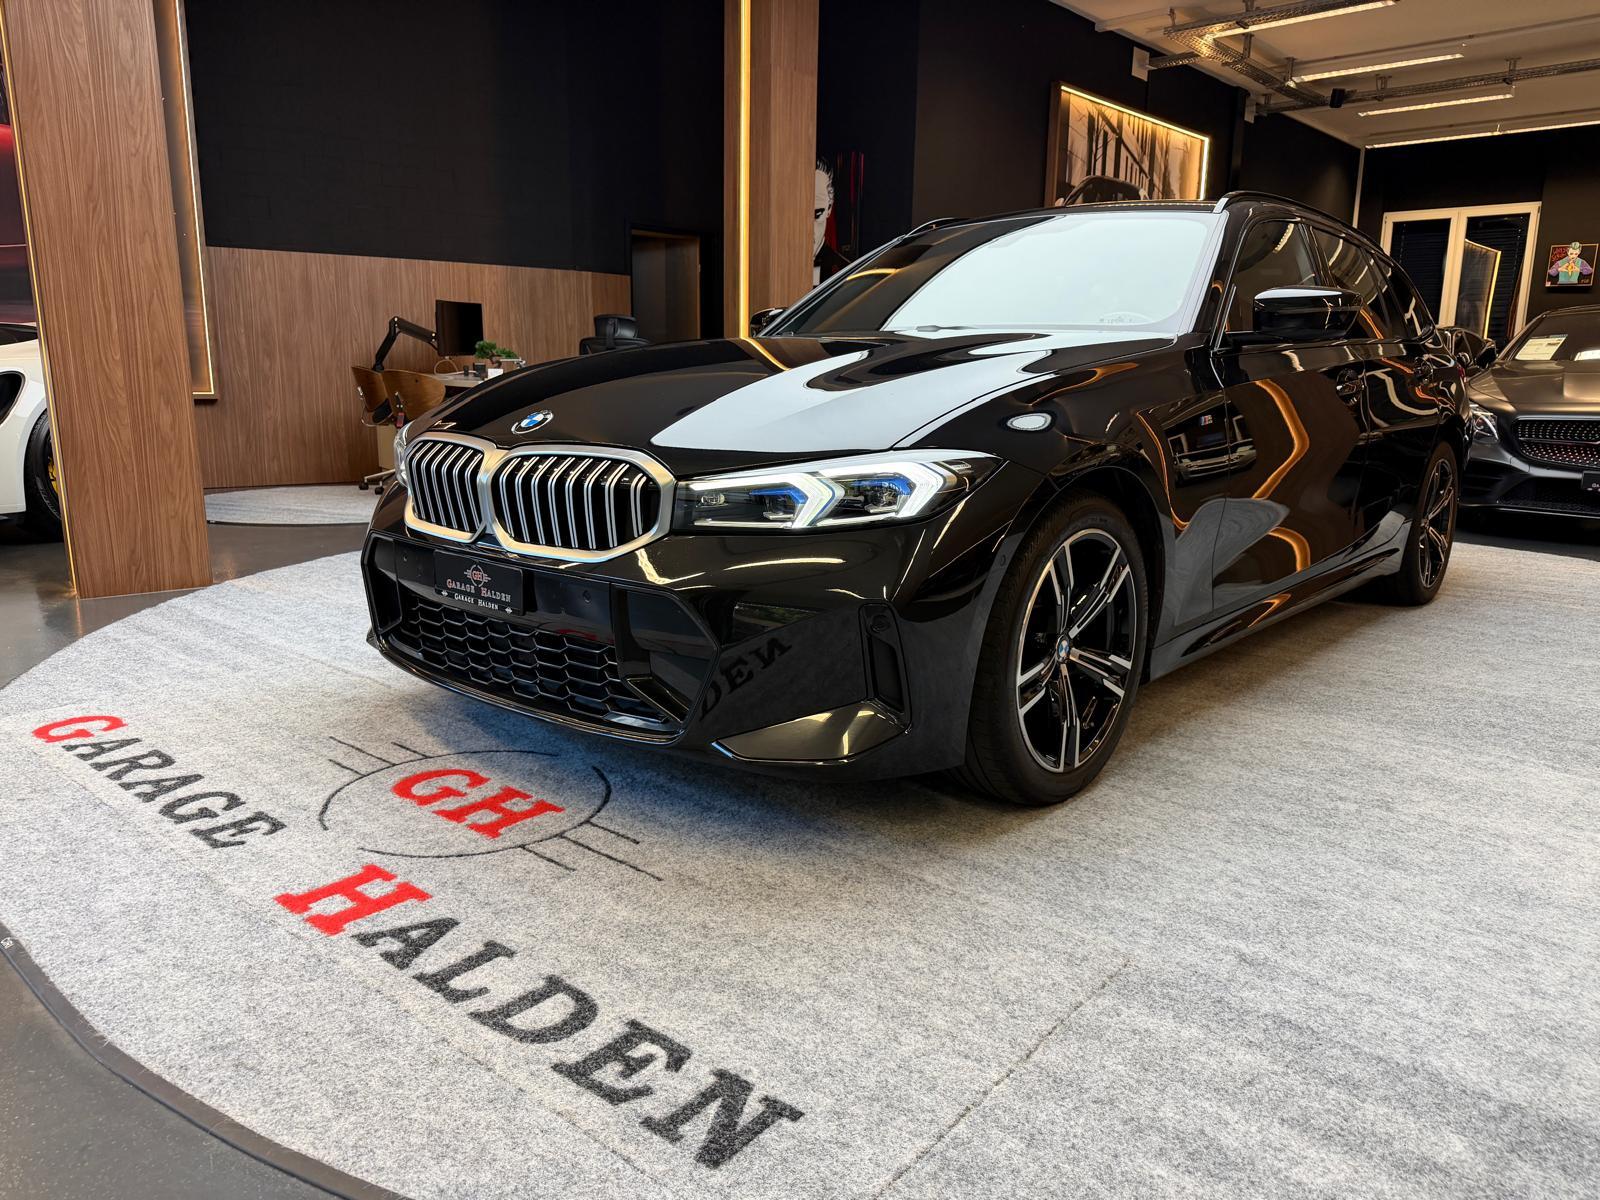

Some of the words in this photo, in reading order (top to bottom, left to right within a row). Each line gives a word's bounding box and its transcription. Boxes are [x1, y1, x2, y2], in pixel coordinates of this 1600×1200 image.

[472, 570, 483, 581] GH
[446, 578, 475, 593] GARAGE
[480, 587, 511, 602] HALDEN
[454, 593, 474, 604] GARAGE
[478, 599, 499, 610] HALDEN
[390, 767, 566, 839] GH
[33, 714, 286, 849] GARAGE
[274, 862, 805, 1169] HALDEN
